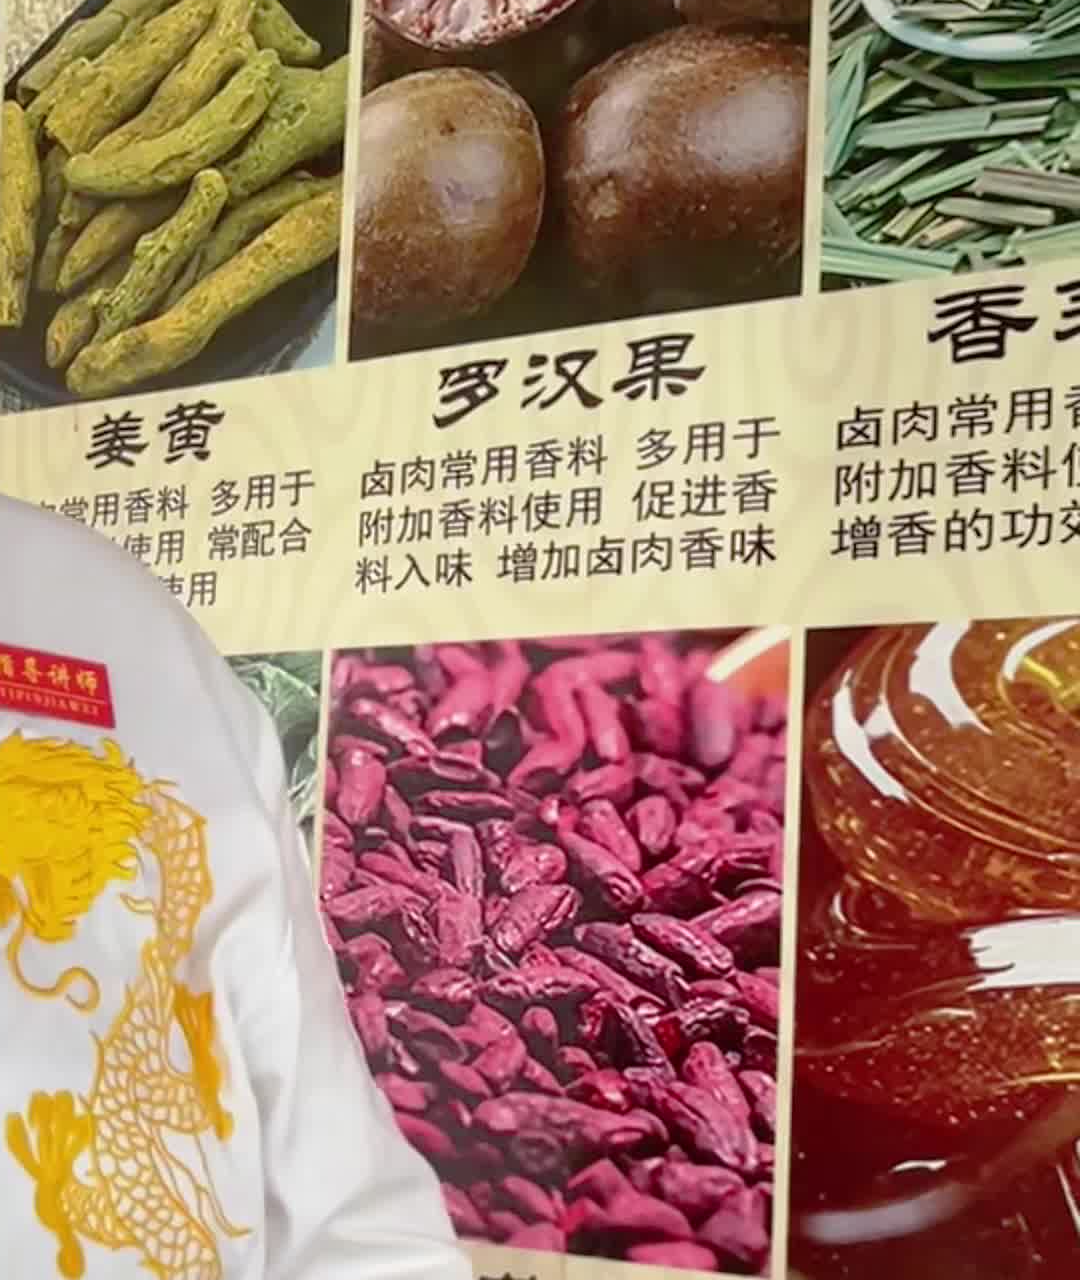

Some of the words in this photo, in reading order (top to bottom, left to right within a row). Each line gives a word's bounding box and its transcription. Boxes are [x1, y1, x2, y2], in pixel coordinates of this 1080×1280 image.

[432, 333, 708, 430] 罗汉果
[85, 400, 226, 471] 姜黄
[359, 433, 609, 501] 卤肉常用香料
[635, 415, 783, 471] 多用于
[40, 484, 190, 529] 常用香料
[211, 469, 316, 518] 多用于
[357, 486, 603, 548] 附加香料使用
[631, 469, 779, 523] 促进香
[112, 529, 186, 568] 使用
[207, 516, 313, 562] 常配合
[354, 551, 474, 596] 料入味
[496, 522, 778, 584] 增加卤肉香味
